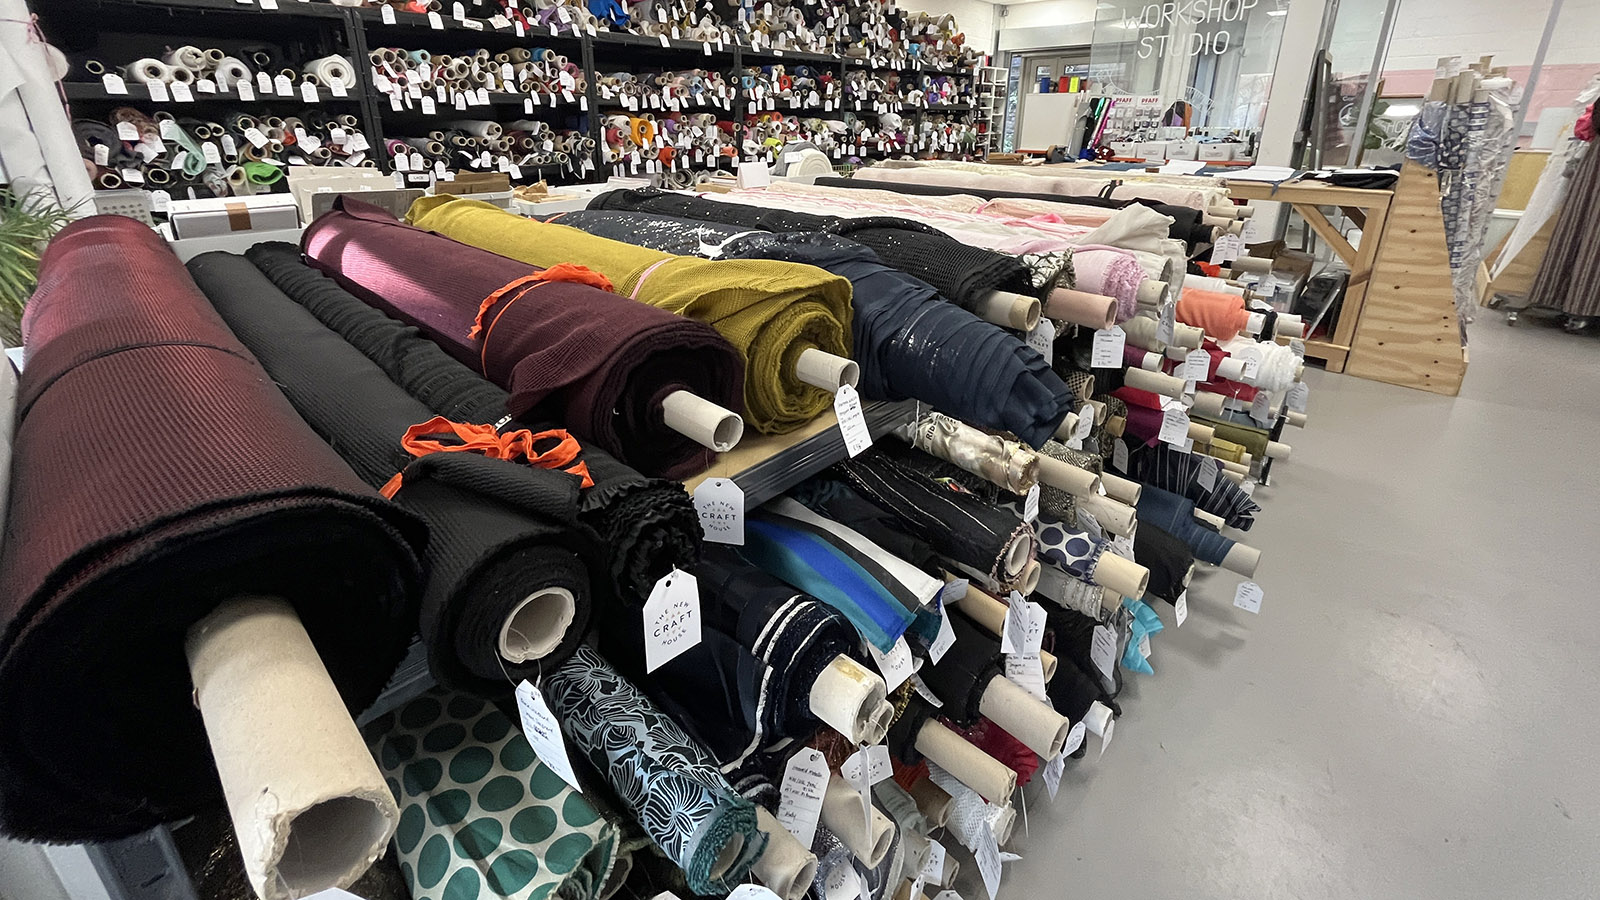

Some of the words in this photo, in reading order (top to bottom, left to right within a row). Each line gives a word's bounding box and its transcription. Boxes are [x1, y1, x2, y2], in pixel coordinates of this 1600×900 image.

[1121, 0, 1258, 29] WORKSHOP
[1137, 31, 1230, 59] STUDIO
[702, 501, 715, 510] THE
[720, 501, 735, 511] NEW
[701, 512, 736, 521] CRAFT
[709, 523, 732, 532] HOUSE
[655, 609, 669, 625] THE
[673, 601, 689, 609] NEW
[653, 610, 692, 638] CRAFT
[661, 630, 686, 646] HOUSE
